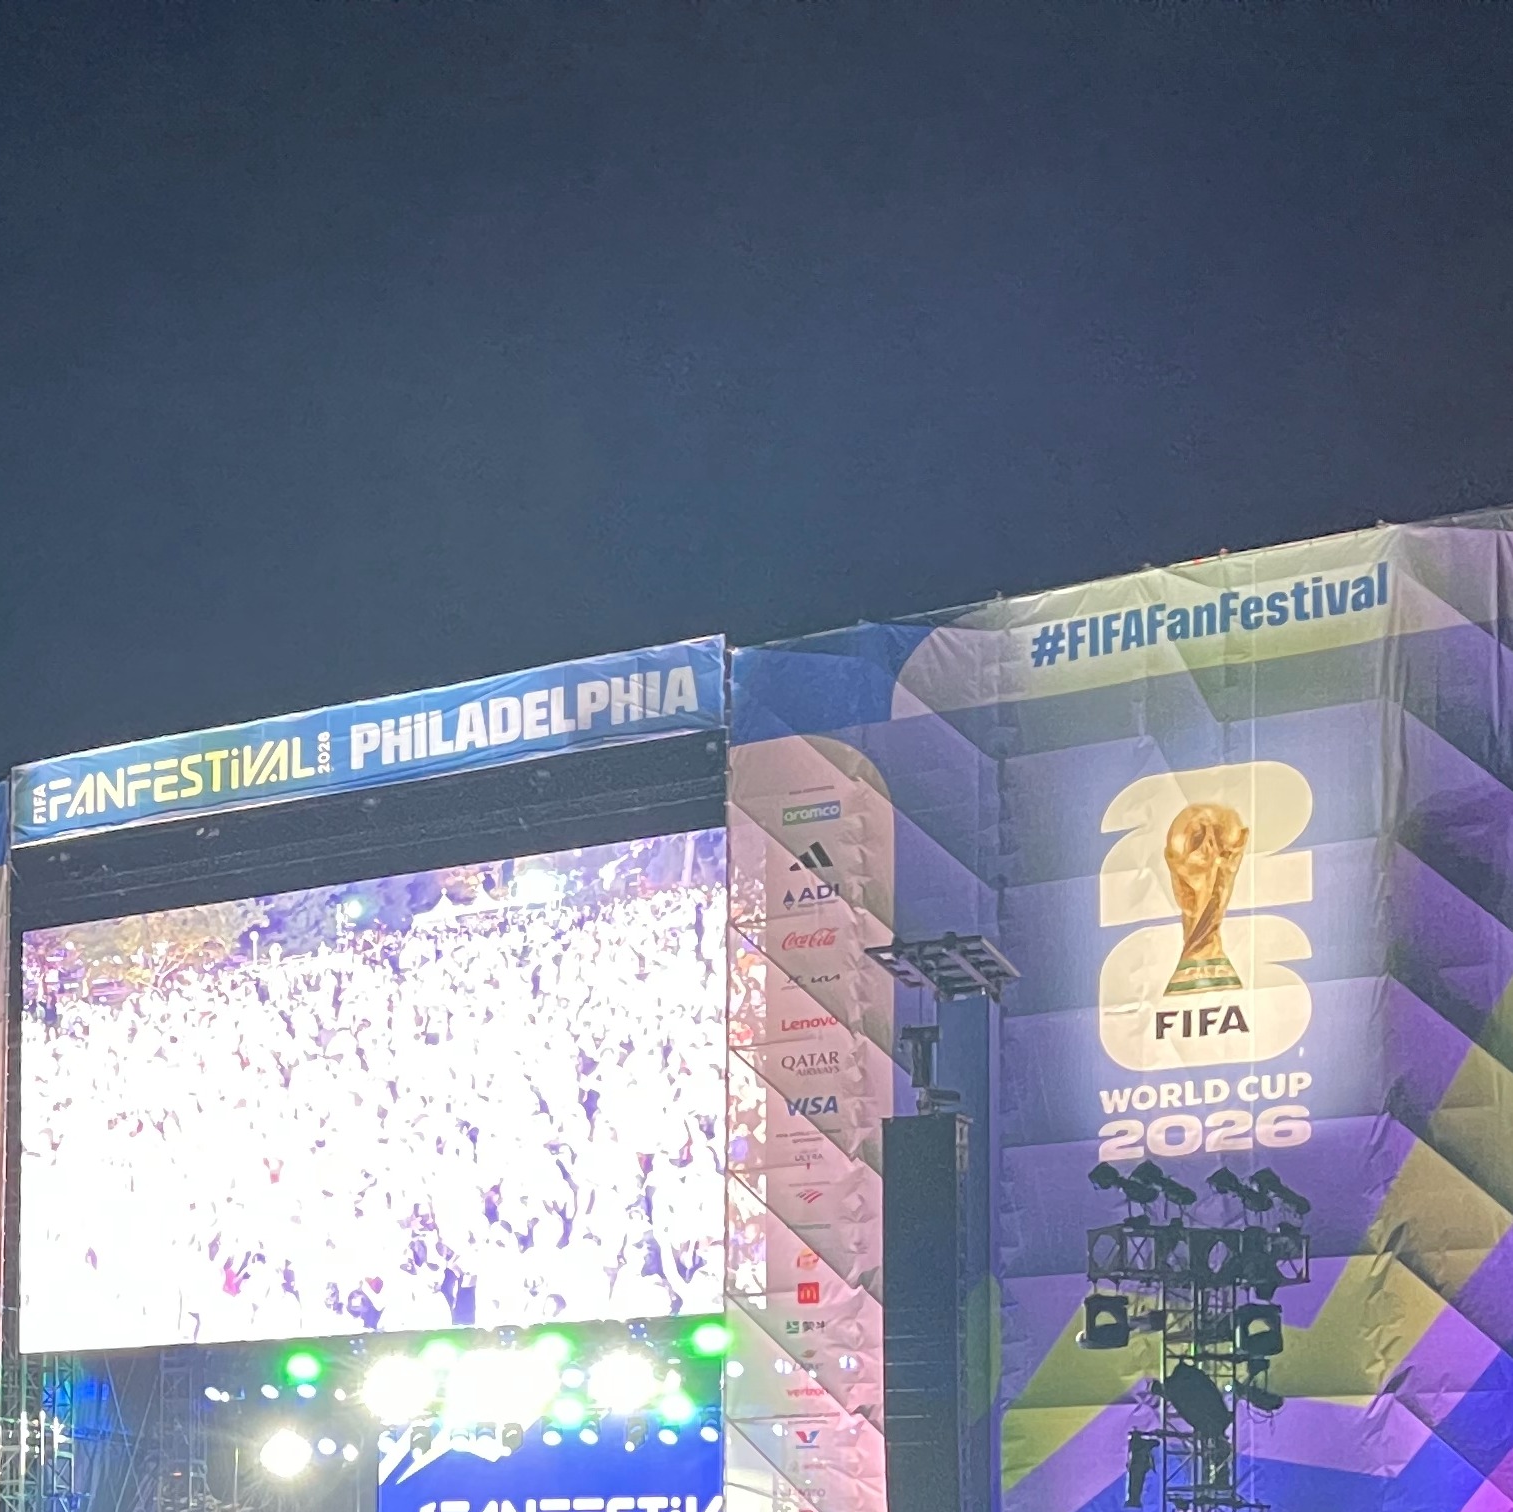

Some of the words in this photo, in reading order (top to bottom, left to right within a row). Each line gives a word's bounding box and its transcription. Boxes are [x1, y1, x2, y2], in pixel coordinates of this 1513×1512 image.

[1030, 562, 1388, 668] #FIFAFanFestival
[32, 783, 47, 824] FIFA
[317, 730, 333, 774] 2026
[350, 665, 699, 770] PHILADELPHIA
[783, 803, 840, 822] aramco
[799, 883, 840, 902] ADI
[781, 1015, 838, 1032] Lenovo
[1155, 1004, 1250, 1040] FIFA
[780, 1050, 840, 1072] QATAR
[784, 1095, 839, 1117] VISA
[1099, 1078, 1230, 1114] WORLD
[1237, 1071, 1313, 1102] CUP
[1098, 1104, 1312, 1163] 2026
